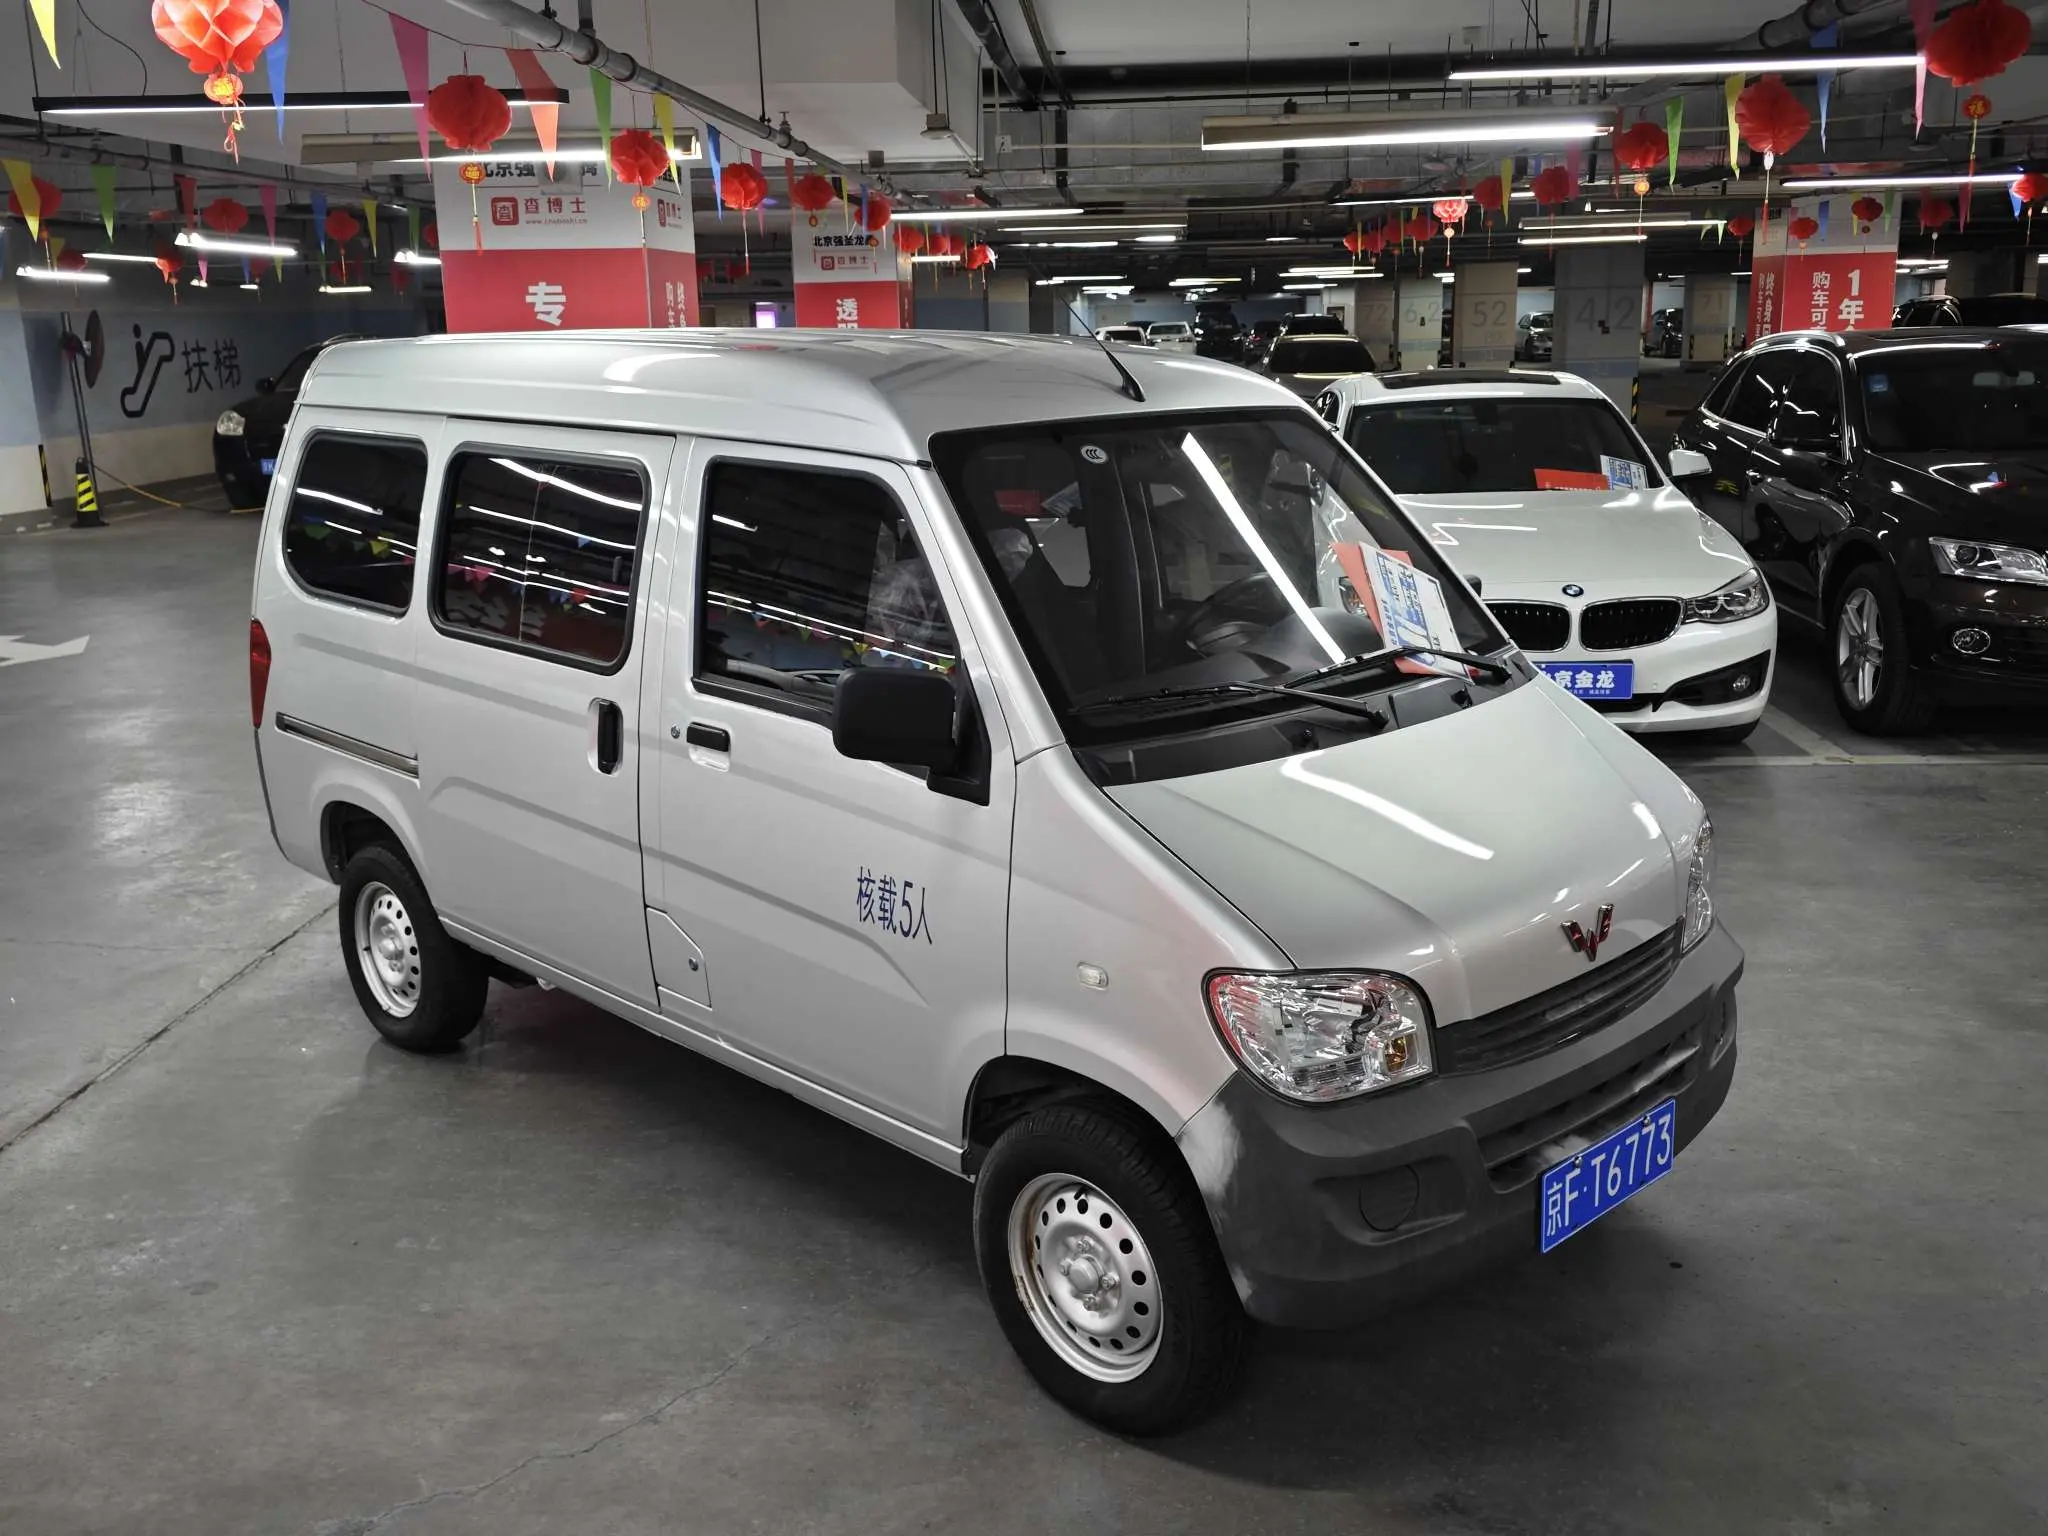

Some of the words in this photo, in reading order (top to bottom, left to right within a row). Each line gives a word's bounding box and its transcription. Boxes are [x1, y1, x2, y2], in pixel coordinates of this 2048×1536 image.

[524, 198, 586, 214] 查博士
[525, 282, 567, 327] 专
[1471, 300, 1508, 328] 52
[1810, 271, 1831, 330] 购车可
[1838, 269, 1865, 331] 1年
[182, 338, 242, 393] 扶梯
[1540, 670, 1615, 689] 京金龙
[856, 865, 933, 945] 核载5人
